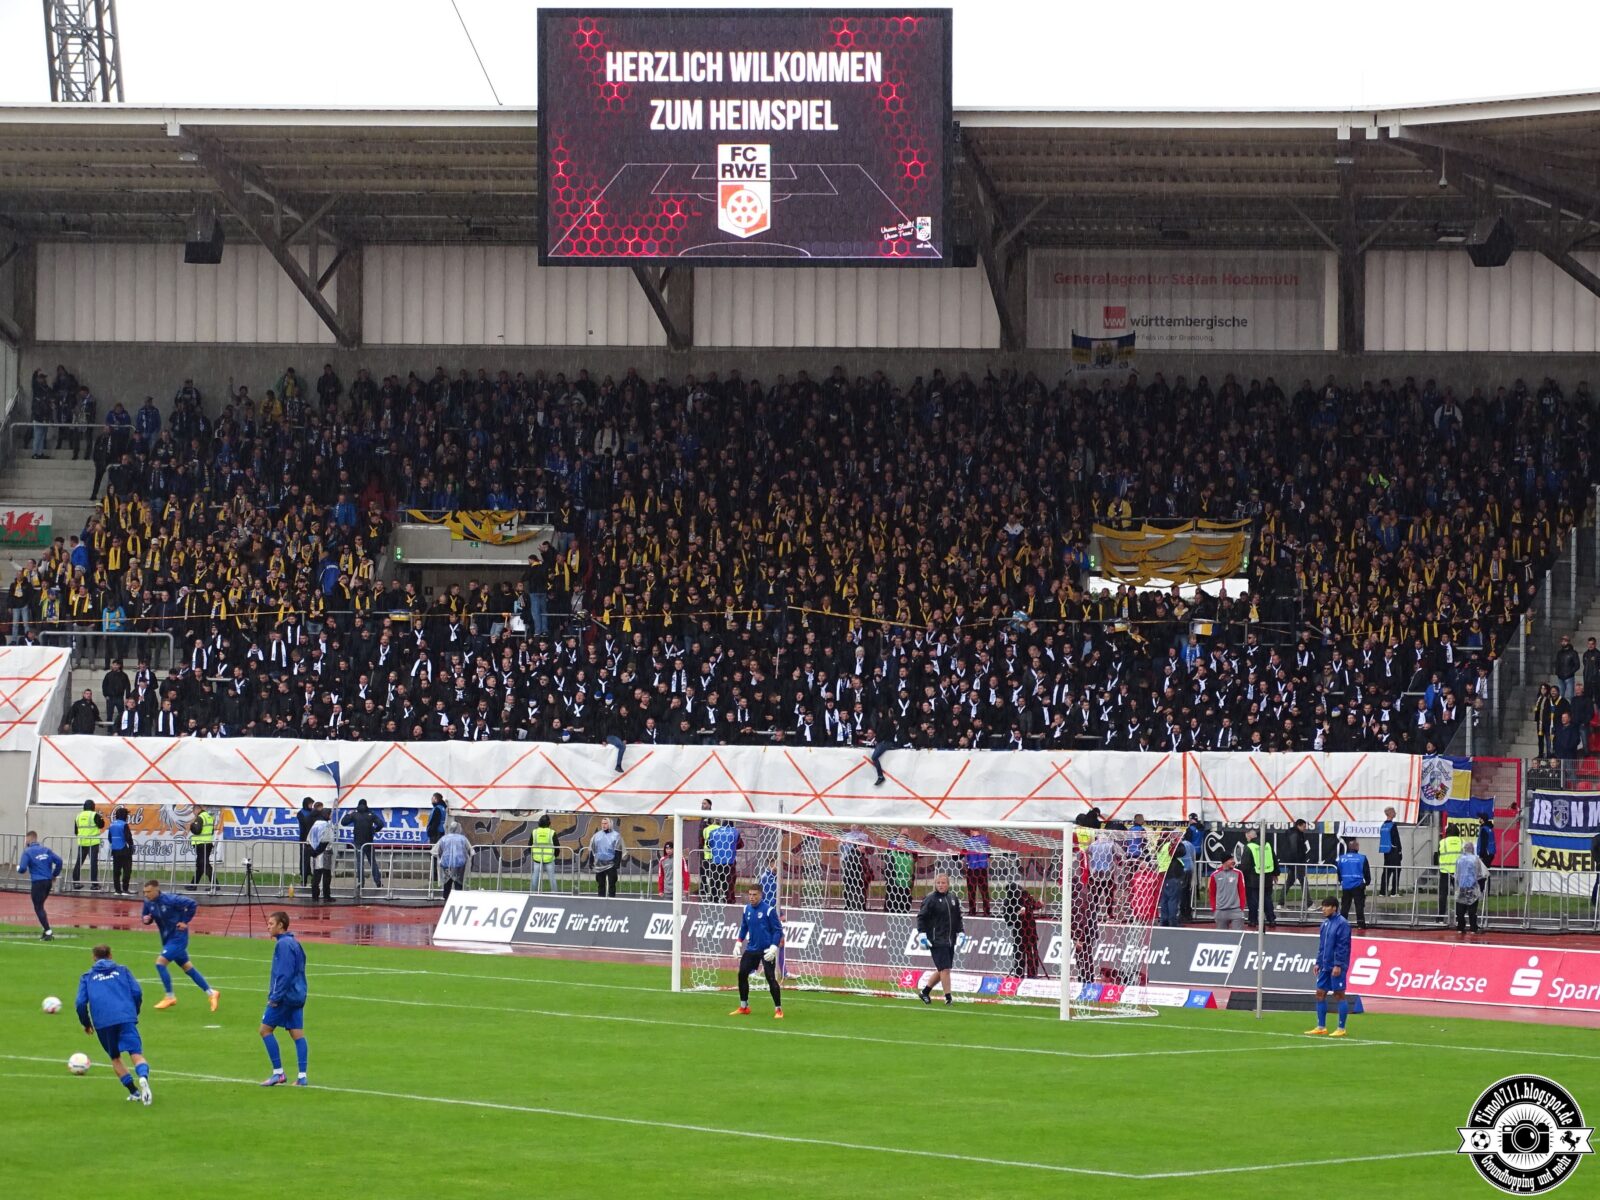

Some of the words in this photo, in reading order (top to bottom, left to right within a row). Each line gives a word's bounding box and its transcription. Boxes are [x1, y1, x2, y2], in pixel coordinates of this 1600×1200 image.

[606, 52, 723, 82] HERZLICH
[730, 52, 882, 82] WILKOMMEN
[650, 100, 702, 131] ZUM
[710, 100, 839, 131] HEIMSPIEL
[730, 146, 757, 162] FC
[721, 163, 767, 178] RWE
[1053, 272, 1168, 287] Generalagentur
[1171, 272, 1217, 285] Stefan
[1222, 273, 1298, 286] Hochmuth
[1130, 315, 1248, 329] württembergische
[529, 911, 559, 929] SWE
[565, 913, 588, 932] Für
[588, 914, 630, 934] Erfurt.
[650, 918, 673, 935] SW
[688, 919, 713, 938] Für
[817, 927, 843, 947] Für
[842, 929, 887, 949] Erfurt.
[1093, 943, 1121, 962] Für
[1121, 944, 1172, 966] Erfurt.
[1196, 948, 1233, 968] SWE
[1272, 952, 1316, 973] Erfur
[1385, 966, 1488, 993] Sparkasse
